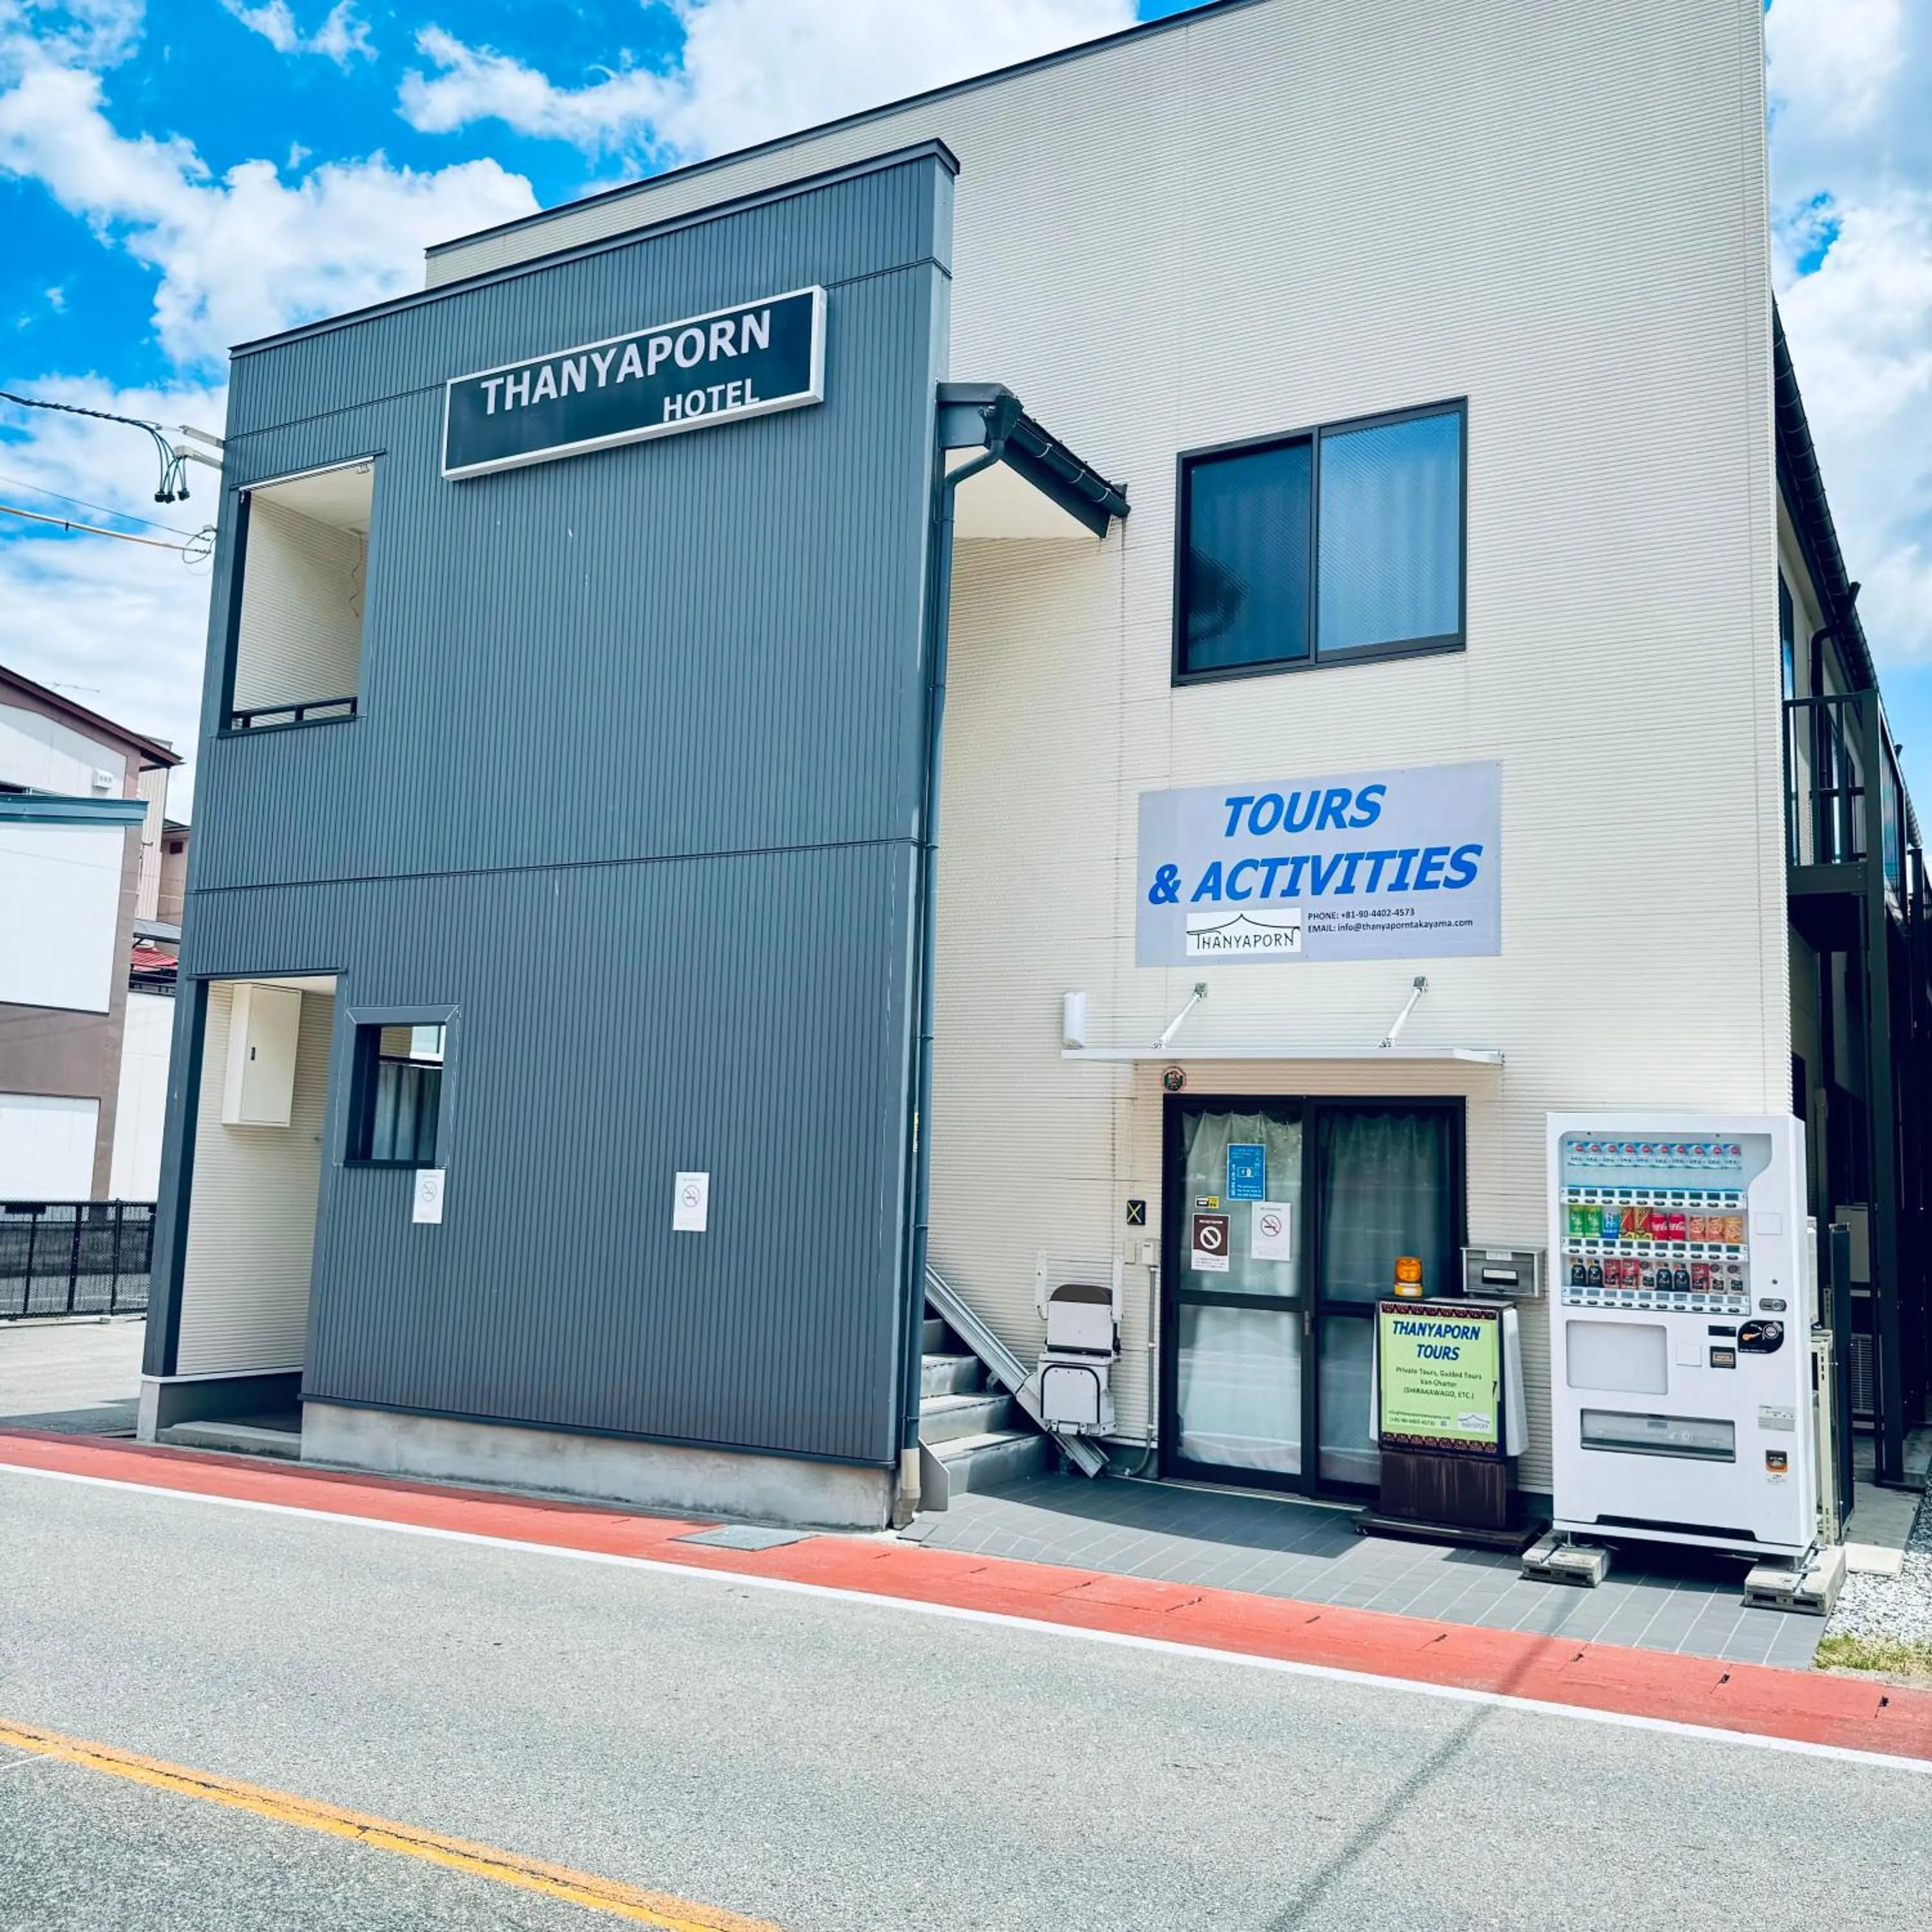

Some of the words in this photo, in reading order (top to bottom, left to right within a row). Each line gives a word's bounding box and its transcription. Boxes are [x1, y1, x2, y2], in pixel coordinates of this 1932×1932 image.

[480, 310, 771, 415] THANYAPORN
[663, 378, 761, 422] HOTEL
[1224, 784, 1387, 837] TOURS
[1148, 863, 1181, 905] &
[1191, 844, 1483, 902] ACTIVITIES
[1308, 911, 1339, 920] PHONE:
[1341, 908, 1416, 919] +81-90-4402-4573
[1308, 924, 1336, 933] EMAIL:
[1338, 920, 1473, 932] info@thanyaporntakayama.com
[1195, 930, 1295, 950] THANYAPORN
[1393, 1320, 1481, 1340] THANYAPORN
[1417, 1343, 1461, 1361] TOURS
[1396, 1366, 1418, 1375] Private
[1439, 1370, 1463, 1378] Guided
[1464, 1372, 1482, 1380] Tours
